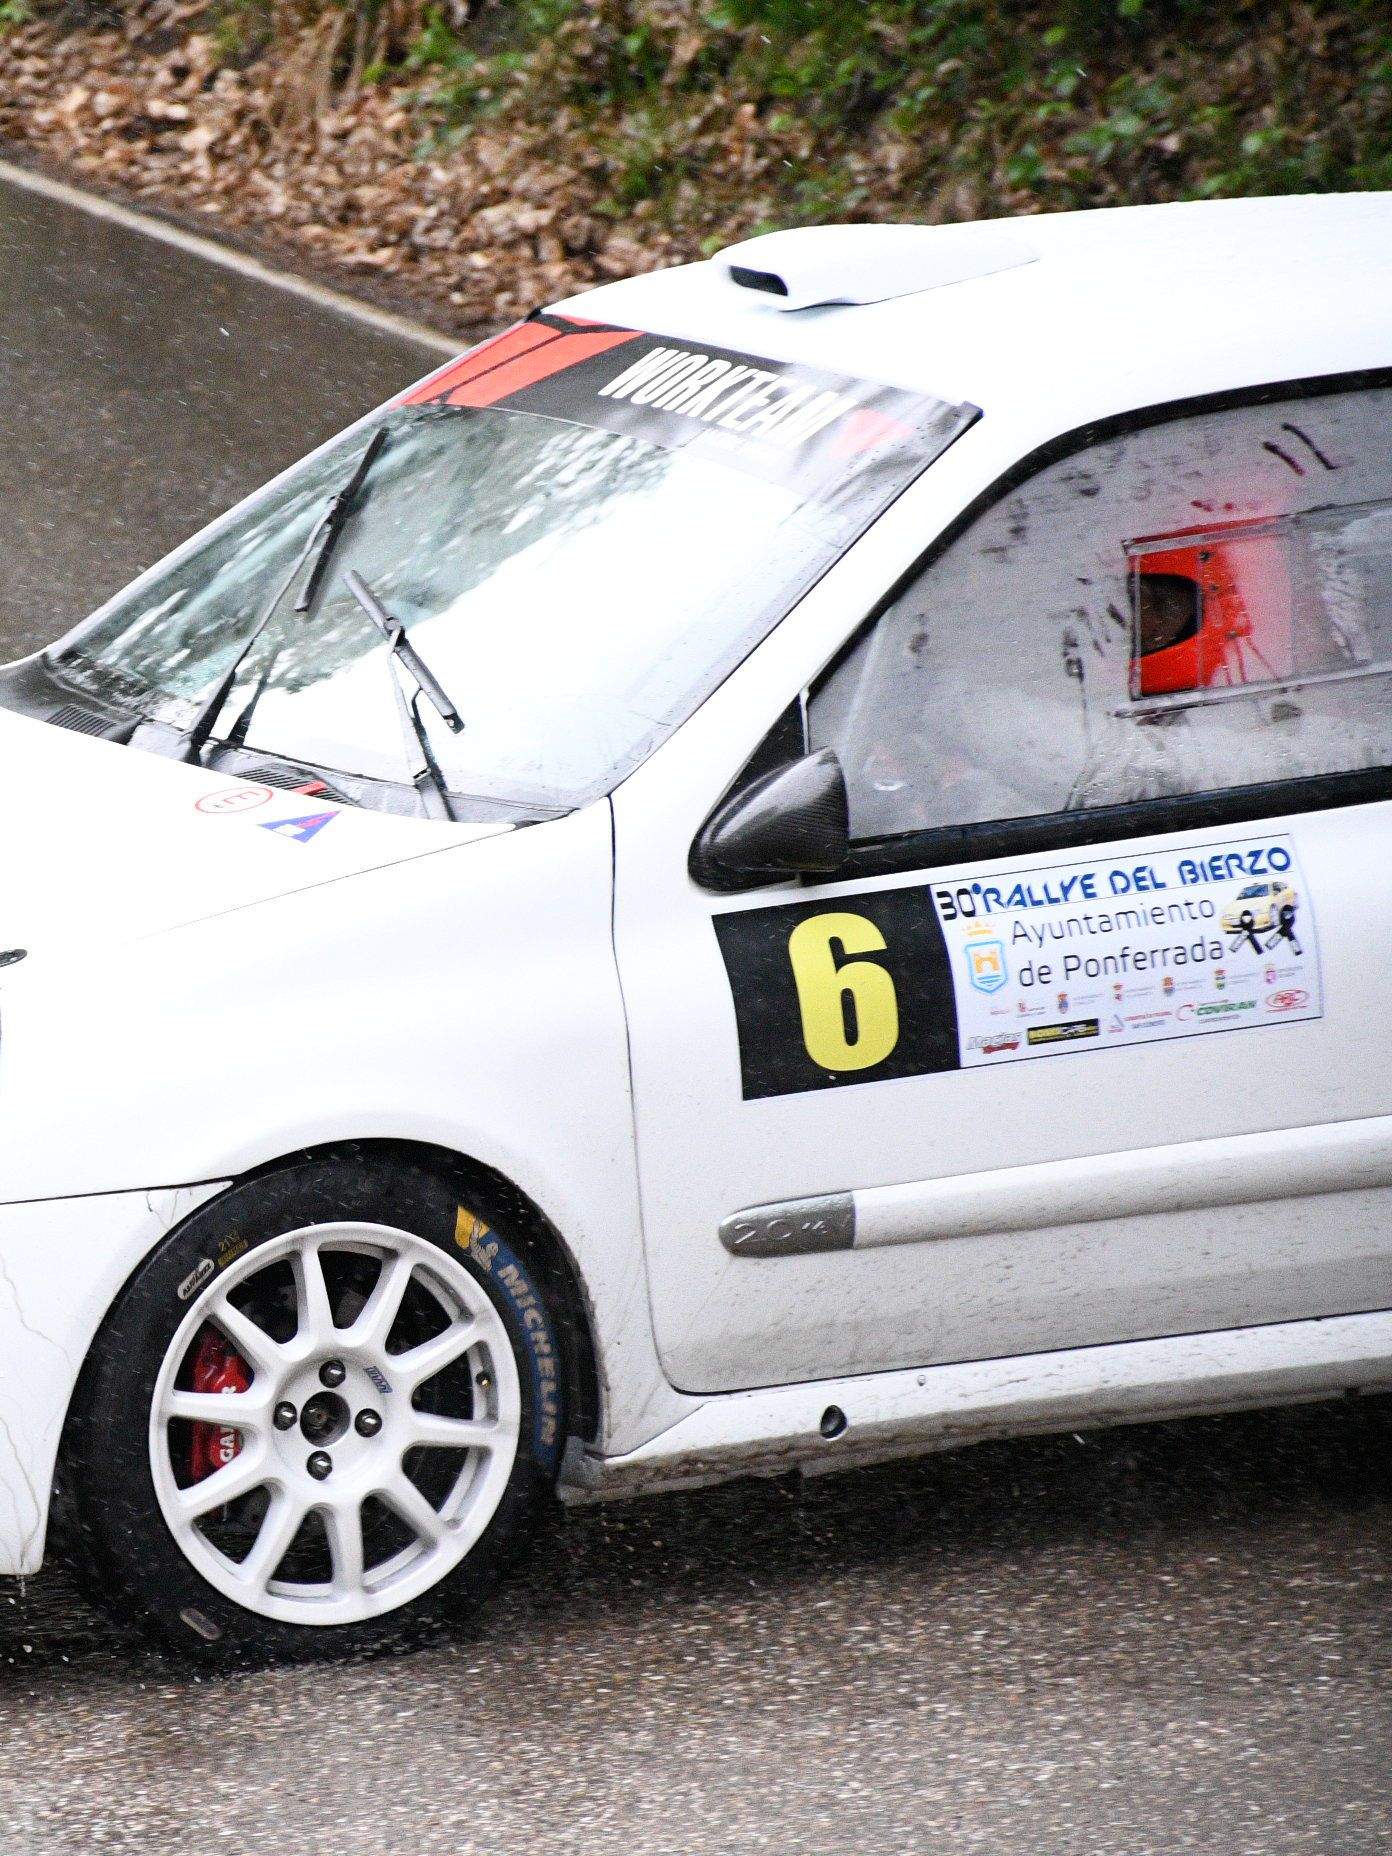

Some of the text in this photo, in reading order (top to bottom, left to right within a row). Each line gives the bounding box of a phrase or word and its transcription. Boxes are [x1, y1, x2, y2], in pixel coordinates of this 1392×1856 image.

[597, 346, 858, 450] WORKTEAM
[1109, 865, 1167, 894] DEL
[1179, 847, 1291, 886] BIERZO
[1012, 899, 1215, 949] Ayuntamiento
[1019, 936, 1224, 987] de Ponferrada
[788, 912, 900, 1073] 6
[497, 1263, 558, 1446] MICHELIN
